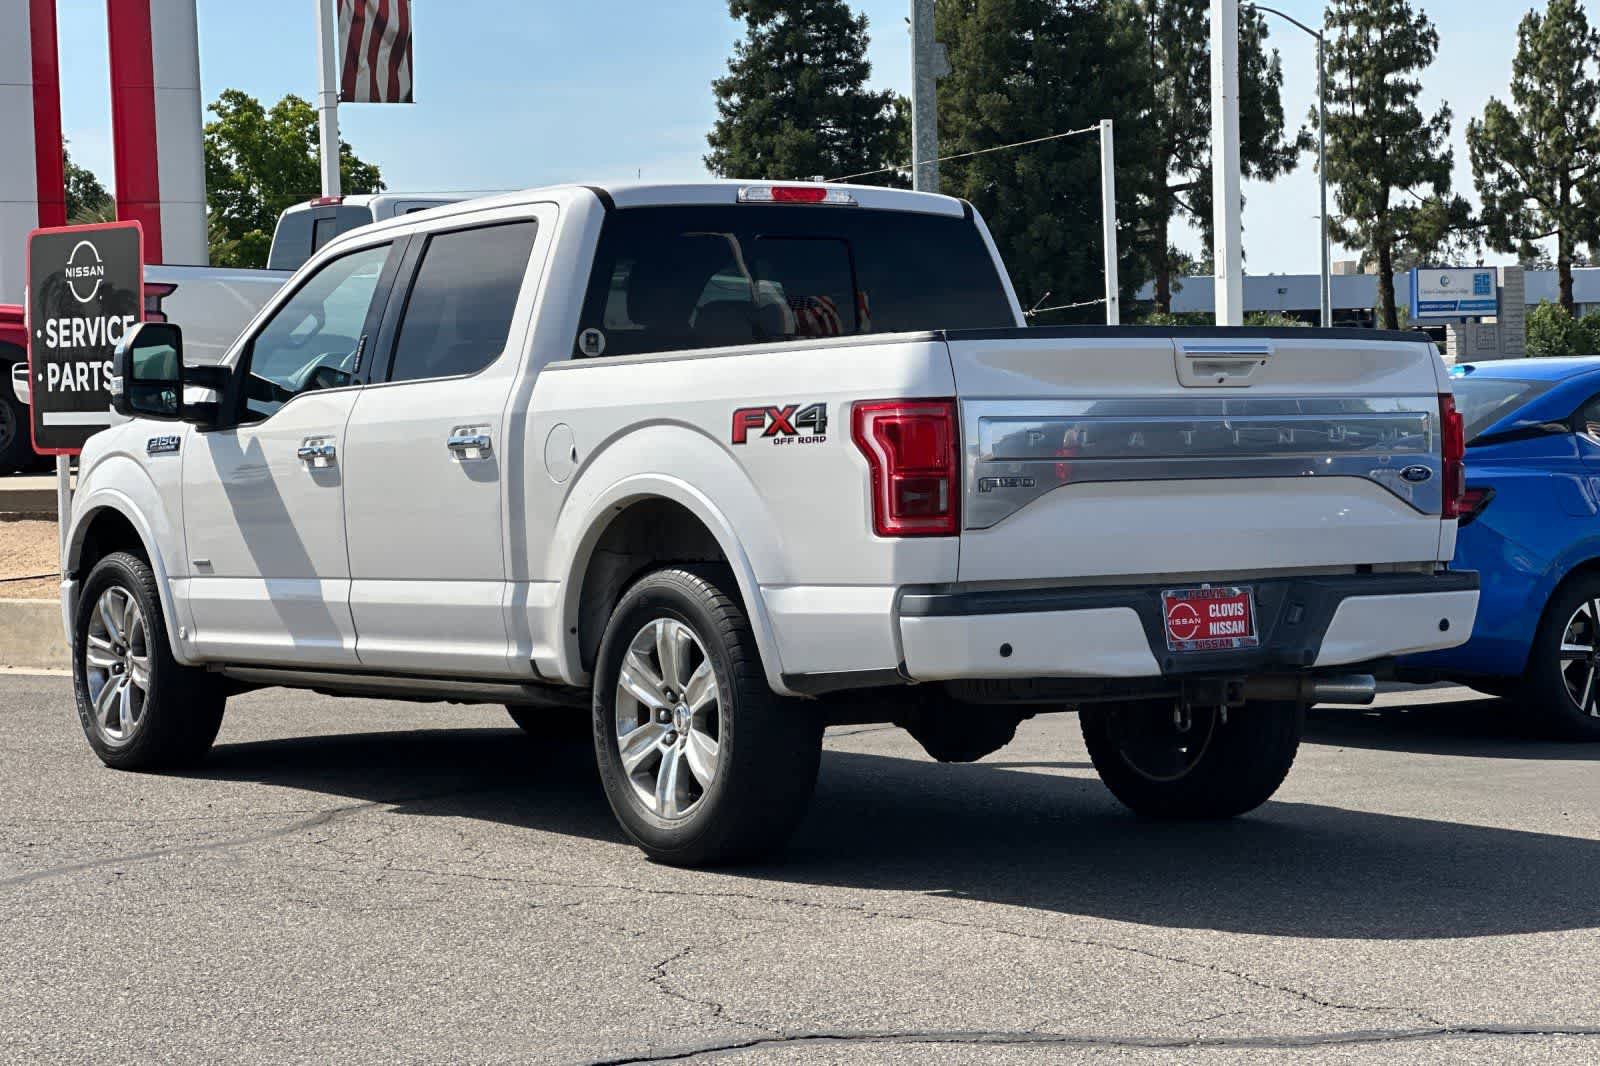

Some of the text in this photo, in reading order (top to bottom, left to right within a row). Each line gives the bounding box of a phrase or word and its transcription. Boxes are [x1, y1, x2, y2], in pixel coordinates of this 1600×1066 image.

[65, 265, 104, 278] NISSAN
[47, 360, 114, 392] PARTS
[732, 402, 827, 444] FX4
[773, 435, 827, 445] OFF ROAD
[1208, 602, 1244, 618] CLOVIS
[1167, 617, 1201, 626] NISSAN
[1209, 620, 1245, 636] NISSAN
